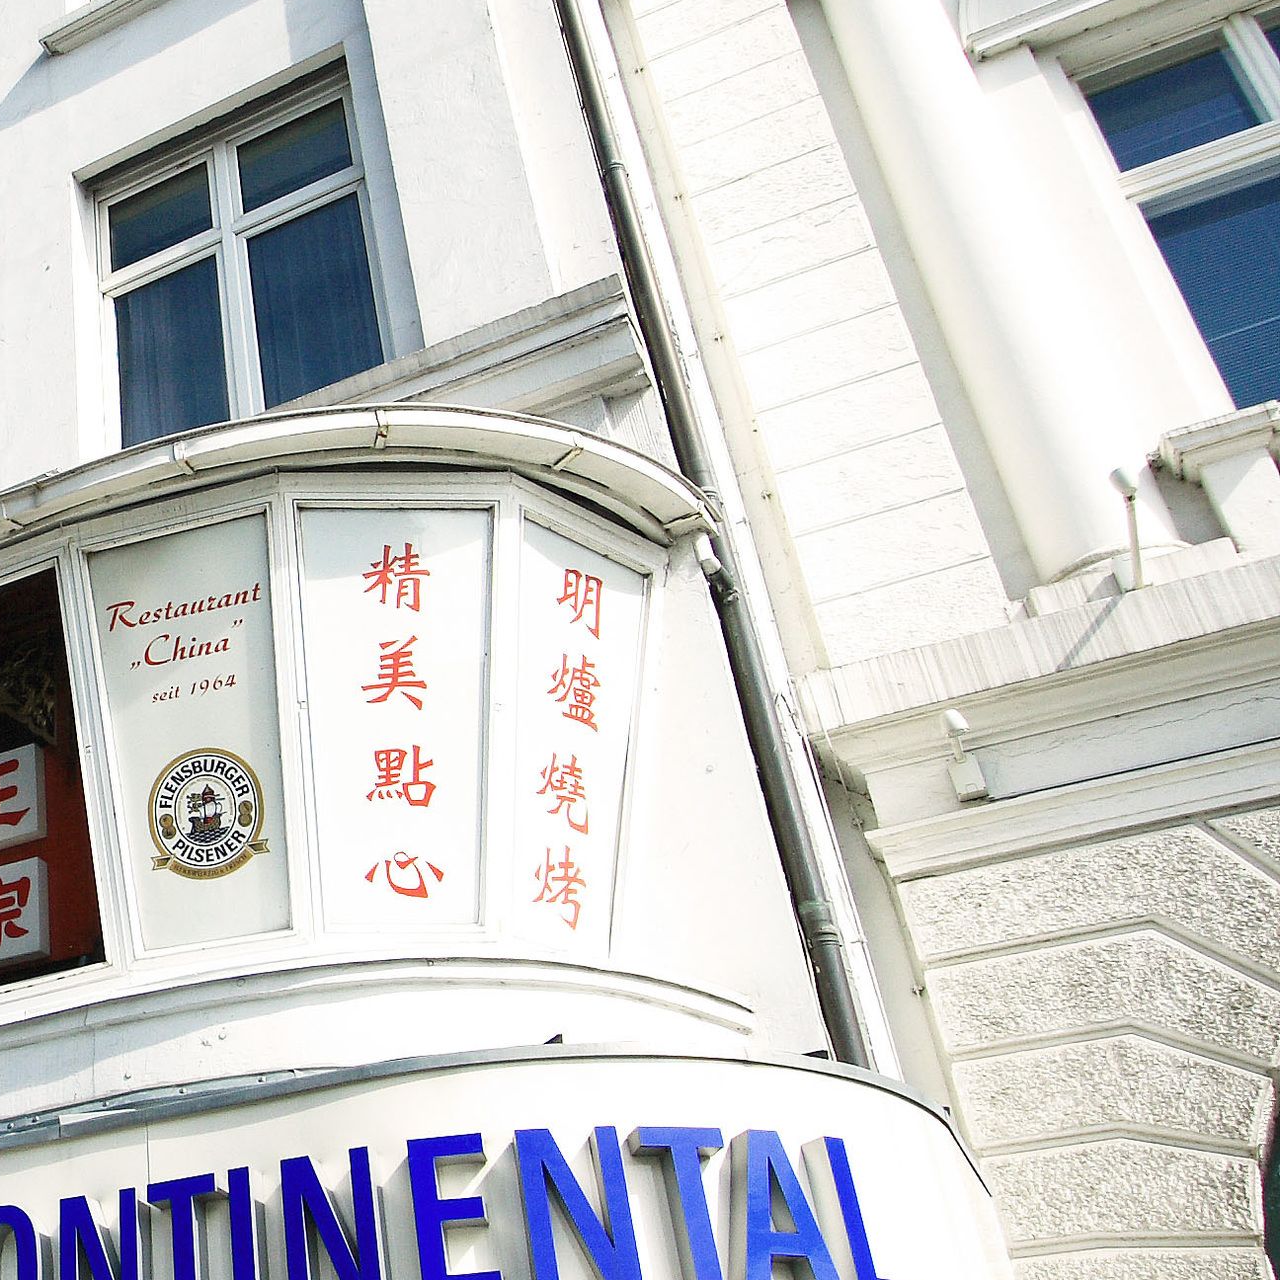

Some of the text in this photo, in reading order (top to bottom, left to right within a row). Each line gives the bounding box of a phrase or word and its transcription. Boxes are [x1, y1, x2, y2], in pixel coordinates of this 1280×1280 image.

[106, 582, 262, 632] Restaurant
[152, 673, 237, 704] seit 1964
[361, 542, 444, 899] 精美點心
[532, 568, 605, 931] 明爐燒烤
[160, 759, 250, 809] FLENSBURGER
[172, 830, 246, 863] PILSENER
